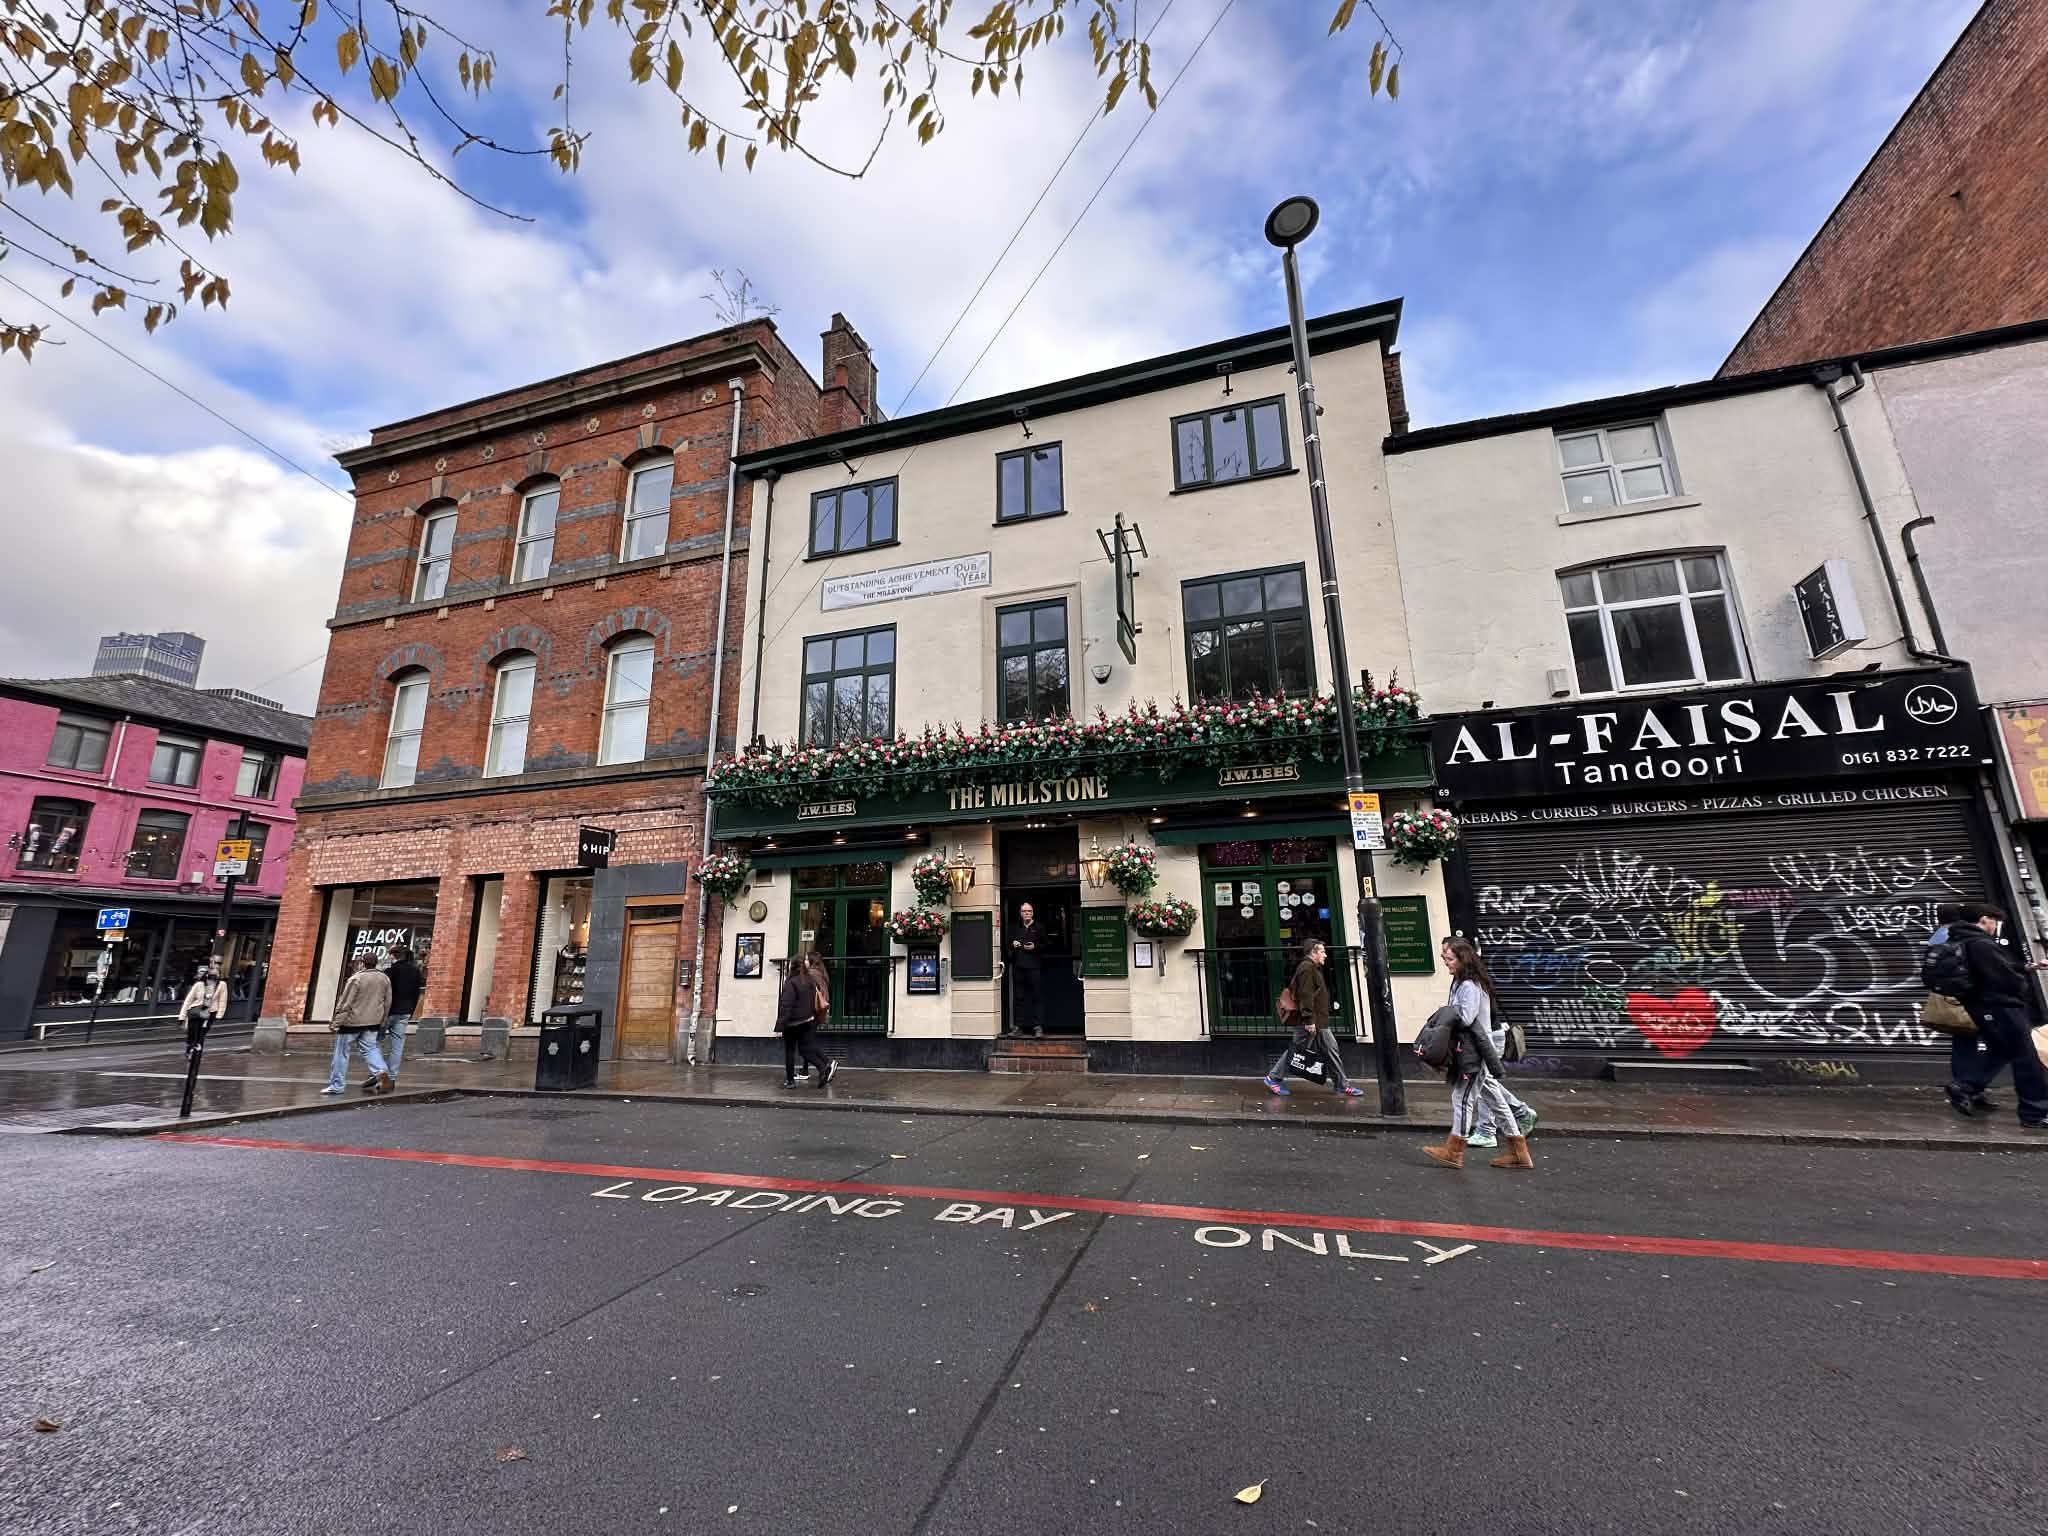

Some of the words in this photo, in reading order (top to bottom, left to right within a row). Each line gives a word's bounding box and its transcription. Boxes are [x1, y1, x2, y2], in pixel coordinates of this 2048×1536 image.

[828, 577, 887, 594] OUTSTANDING
[888, 566, 950, 586] ACHIEVEMENT
[961, 572, 987, 585] YEAR
[1842, 752, 1880, 765] 0161
[1886, 748, 1920, 762] 832
[1925, 744, 1972, 760] 7222
[1555, 749, 1743, 785] Tandoori
[949, 784, 986, 810] THE
[991, 775, 1109, 807] MILLSTONE
[1438, 787, 1450, 797] 69
[1460, 812, 1518, 825] KEBABS
[1531, 805, 1598, 821] CURRIES
[1612, 800, 1687, 815] BURGERS
[1703, 795, 1763, 810] PIZZAS
[1777, 789, 1857, 807] GRILLED
[1862, 785, 1949, 802] CHICKEN
[591, 844, 610, 855] HIP
[356, 928, 408, 945] BLACK
[352, 946, 390, 960] FRID
[591, 1181, 903, 1219] LOADING
[933, 1203, 1075, 1231] BAY
[1194, 1226, 1478, 1264] ONLY
